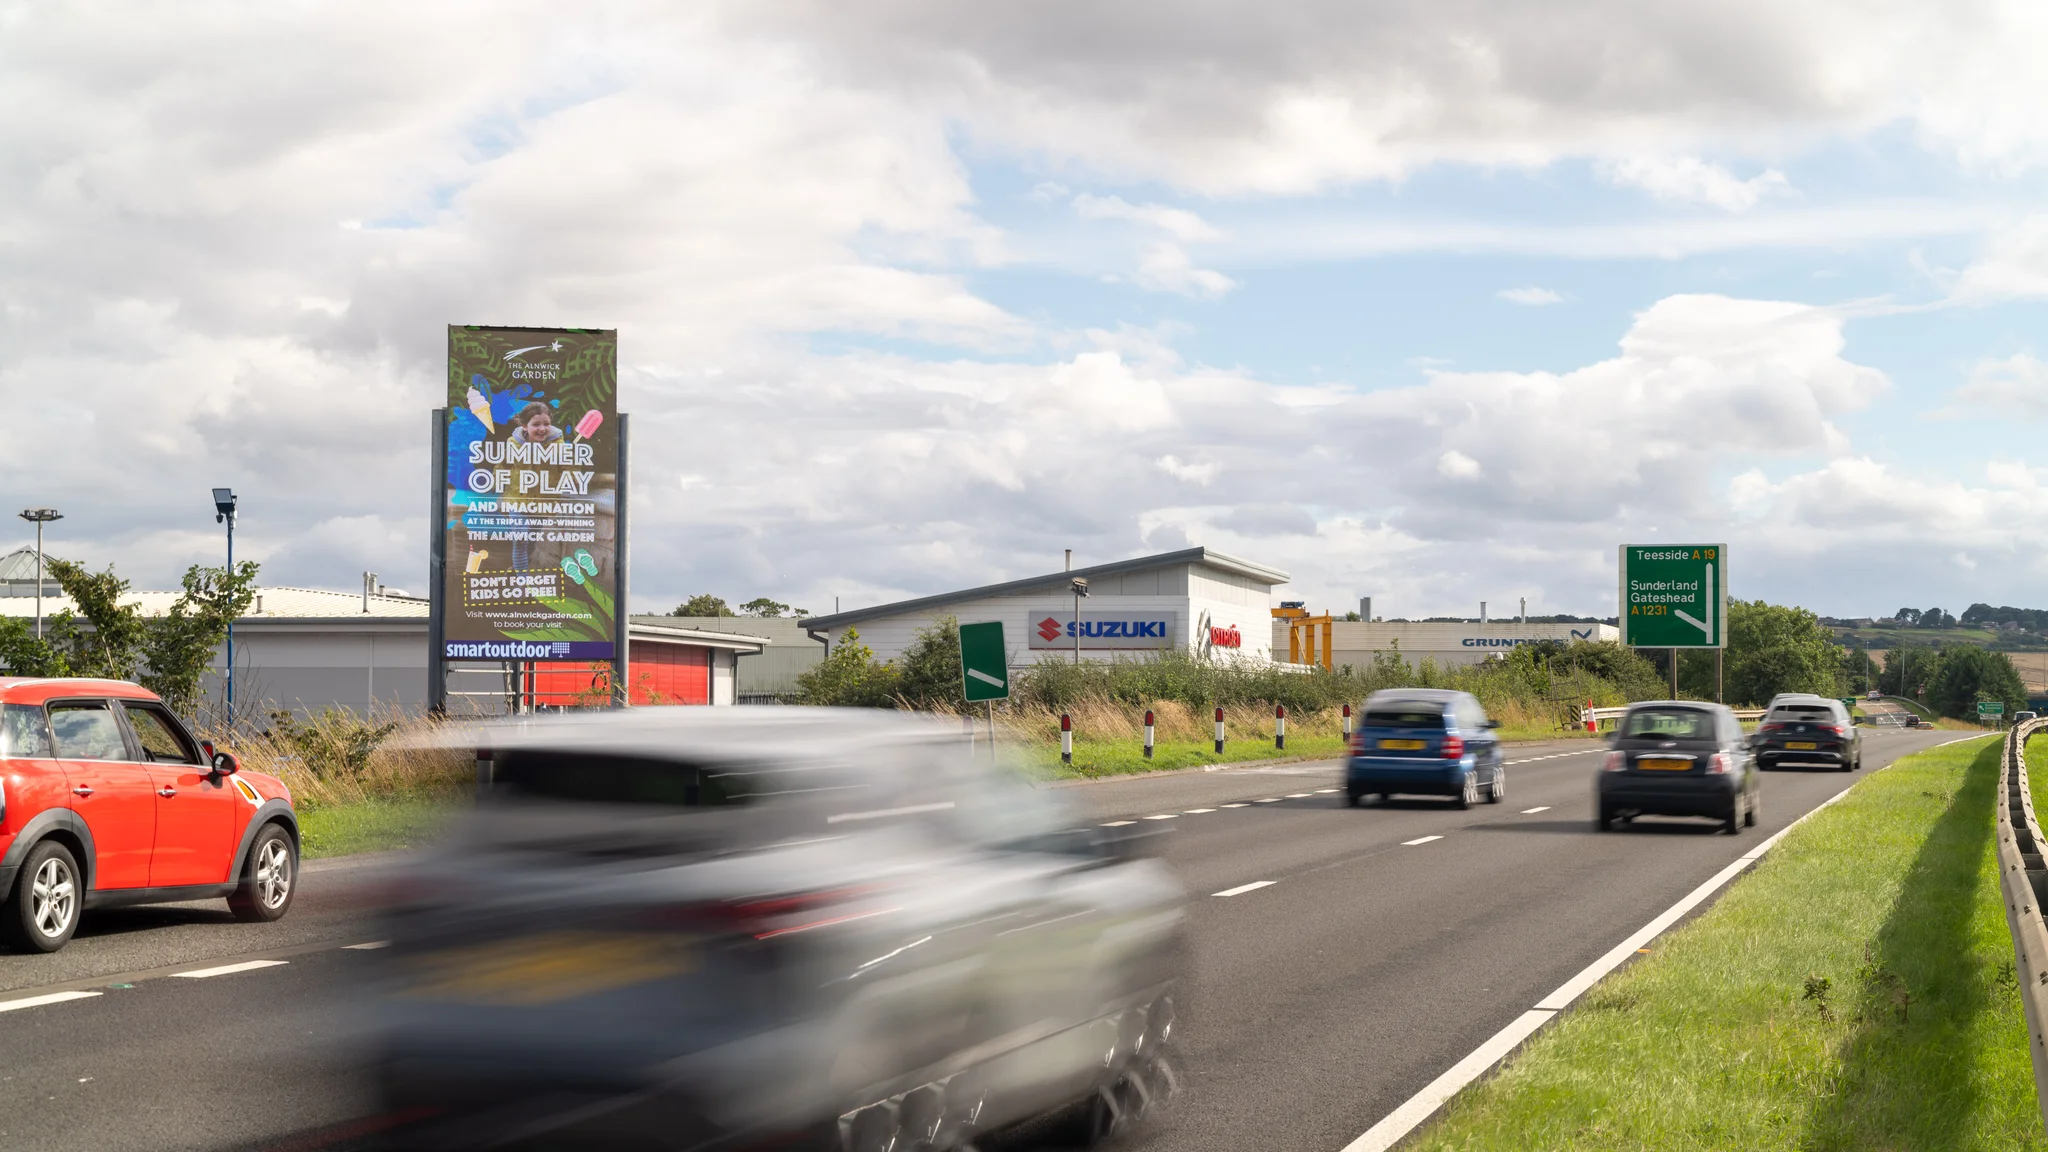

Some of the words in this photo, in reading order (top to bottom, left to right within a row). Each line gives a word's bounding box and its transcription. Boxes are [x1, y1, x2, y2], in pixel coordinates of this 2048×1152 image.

[512, 370, 556, 380] GARDEN
[469, 440, 594, 466] SUMMER
[468, 469, 511, 494] OF
[519, 470, 595, 495] PLAY
[467, 501, 498, 512] AND
[501, 501, 595, 514] IMAGINATION
[467, 517, 478, 525] AT
[524, 518, 595, 527] AWARD-WINNING
[467, 530, 488, 541] THE
[490, 531, 545, 542] ALNWICK
[547, 532, 595, 542] GARDEN
[1637, 550, 1689, 560] Teesside
[1692, 549, 1701, 560] A
[1703, 549, 1716, 560] 19
[470, 576, 508, 588] DON'T
[509, 574, 557, 586] FORGET
[1630, 580, 1698, 591] Sunderland
[470, 588, 500, 600] KIDS
[502, 587, 523, 599] GO
[525, 586, 557, 598] FREE!
[1630, 592, 1695, 603] Gateshead
[485, 611, 592, 620] www.alnwickgarden.com
[1631, 605, 1639, 616] A
[1642, 605, 1667, 616] 1231
[526, 622, 544, 630] your
[1066, 621, 1166, 638] SUZUKI
[446, 640, 552, 658] smartoutdoor
